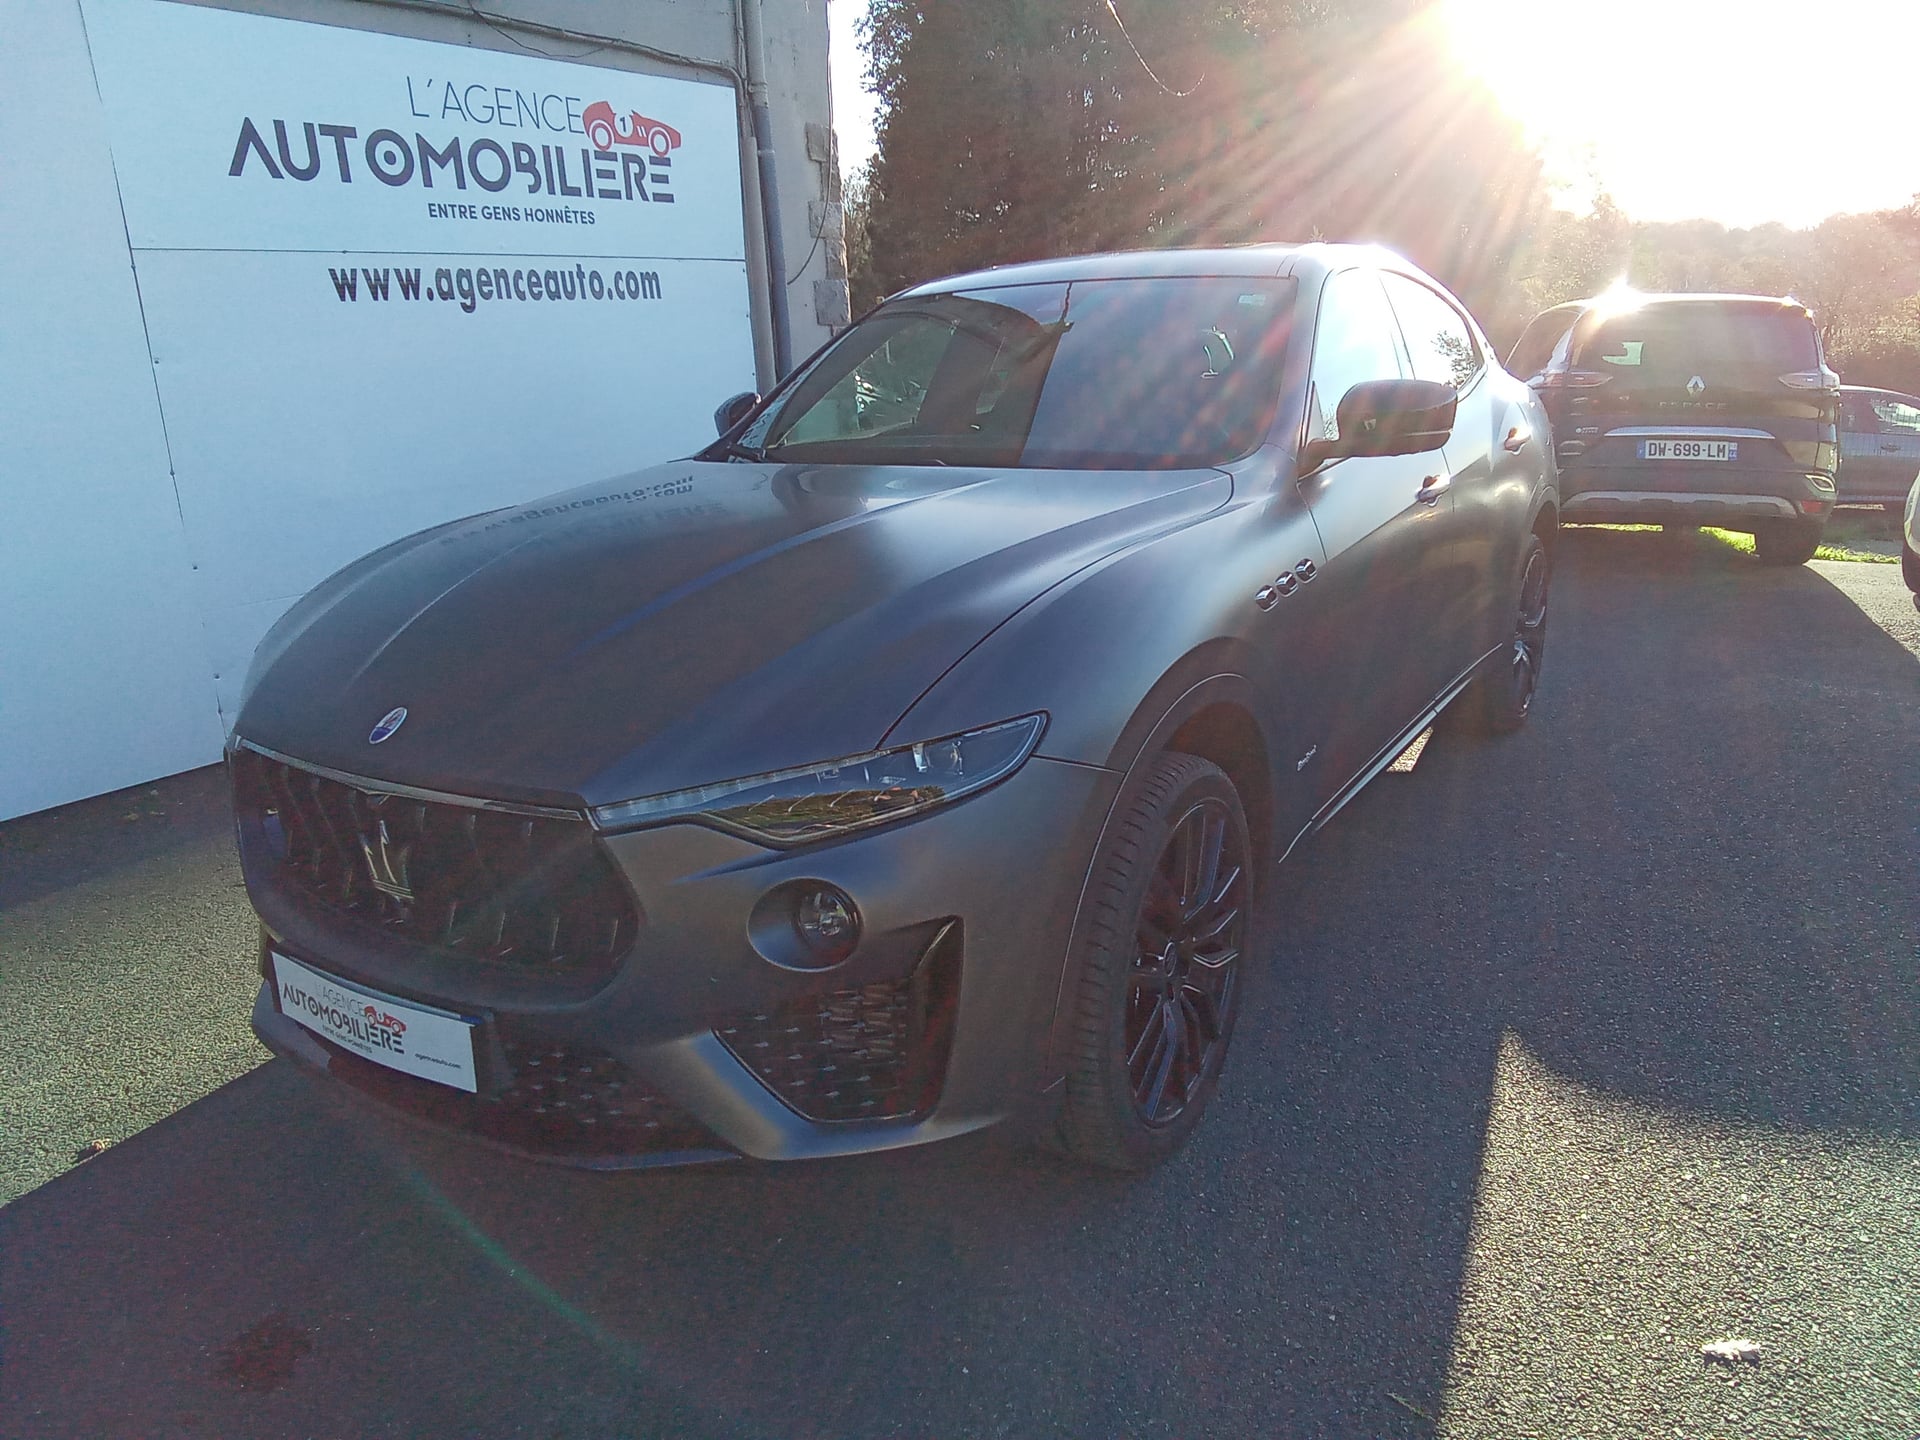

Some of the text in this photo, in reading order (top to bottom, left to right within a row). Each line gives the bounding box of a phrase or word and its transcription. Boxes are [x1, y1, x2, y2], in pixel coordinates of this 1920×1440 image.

[406, 75, 585, 135] L'AGENCE
[427, 202, 596, 225] ENTRE GENS HONNÊTES
[328, 263, 662, 314] www.agenceauto.com
[1647, 442, 1727, 459] DW-699-LM
